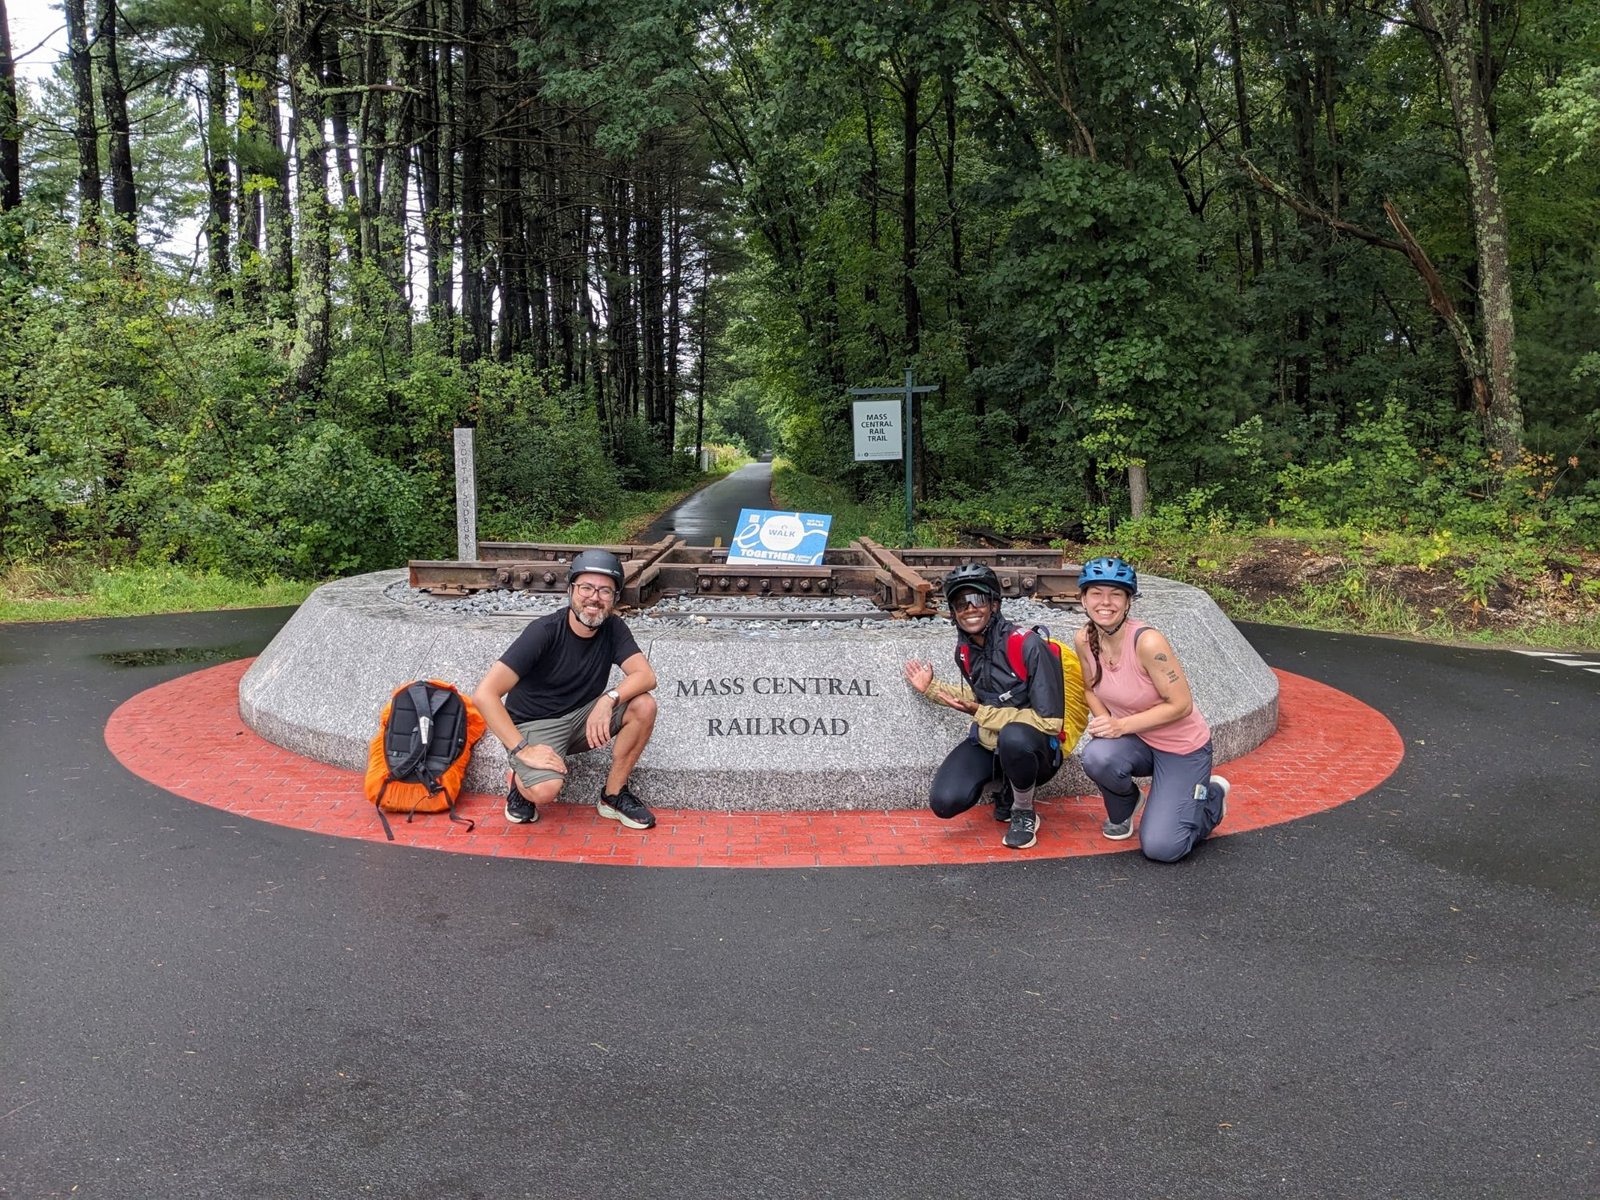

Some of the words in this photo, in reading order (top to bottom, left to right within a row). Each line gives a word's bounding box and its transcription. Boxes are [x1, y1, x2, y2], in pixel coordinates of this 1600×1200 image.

[461, 440, 469, 484] SOUTH
[768, 529, 796, 538] WALK
[740, 548, 796, 561] TOGETHER
[676, 677, 745, 697] MASS
[752, 676, 879, 697] CENTRAL
[707, 717, 850, 737] RAILROAD
